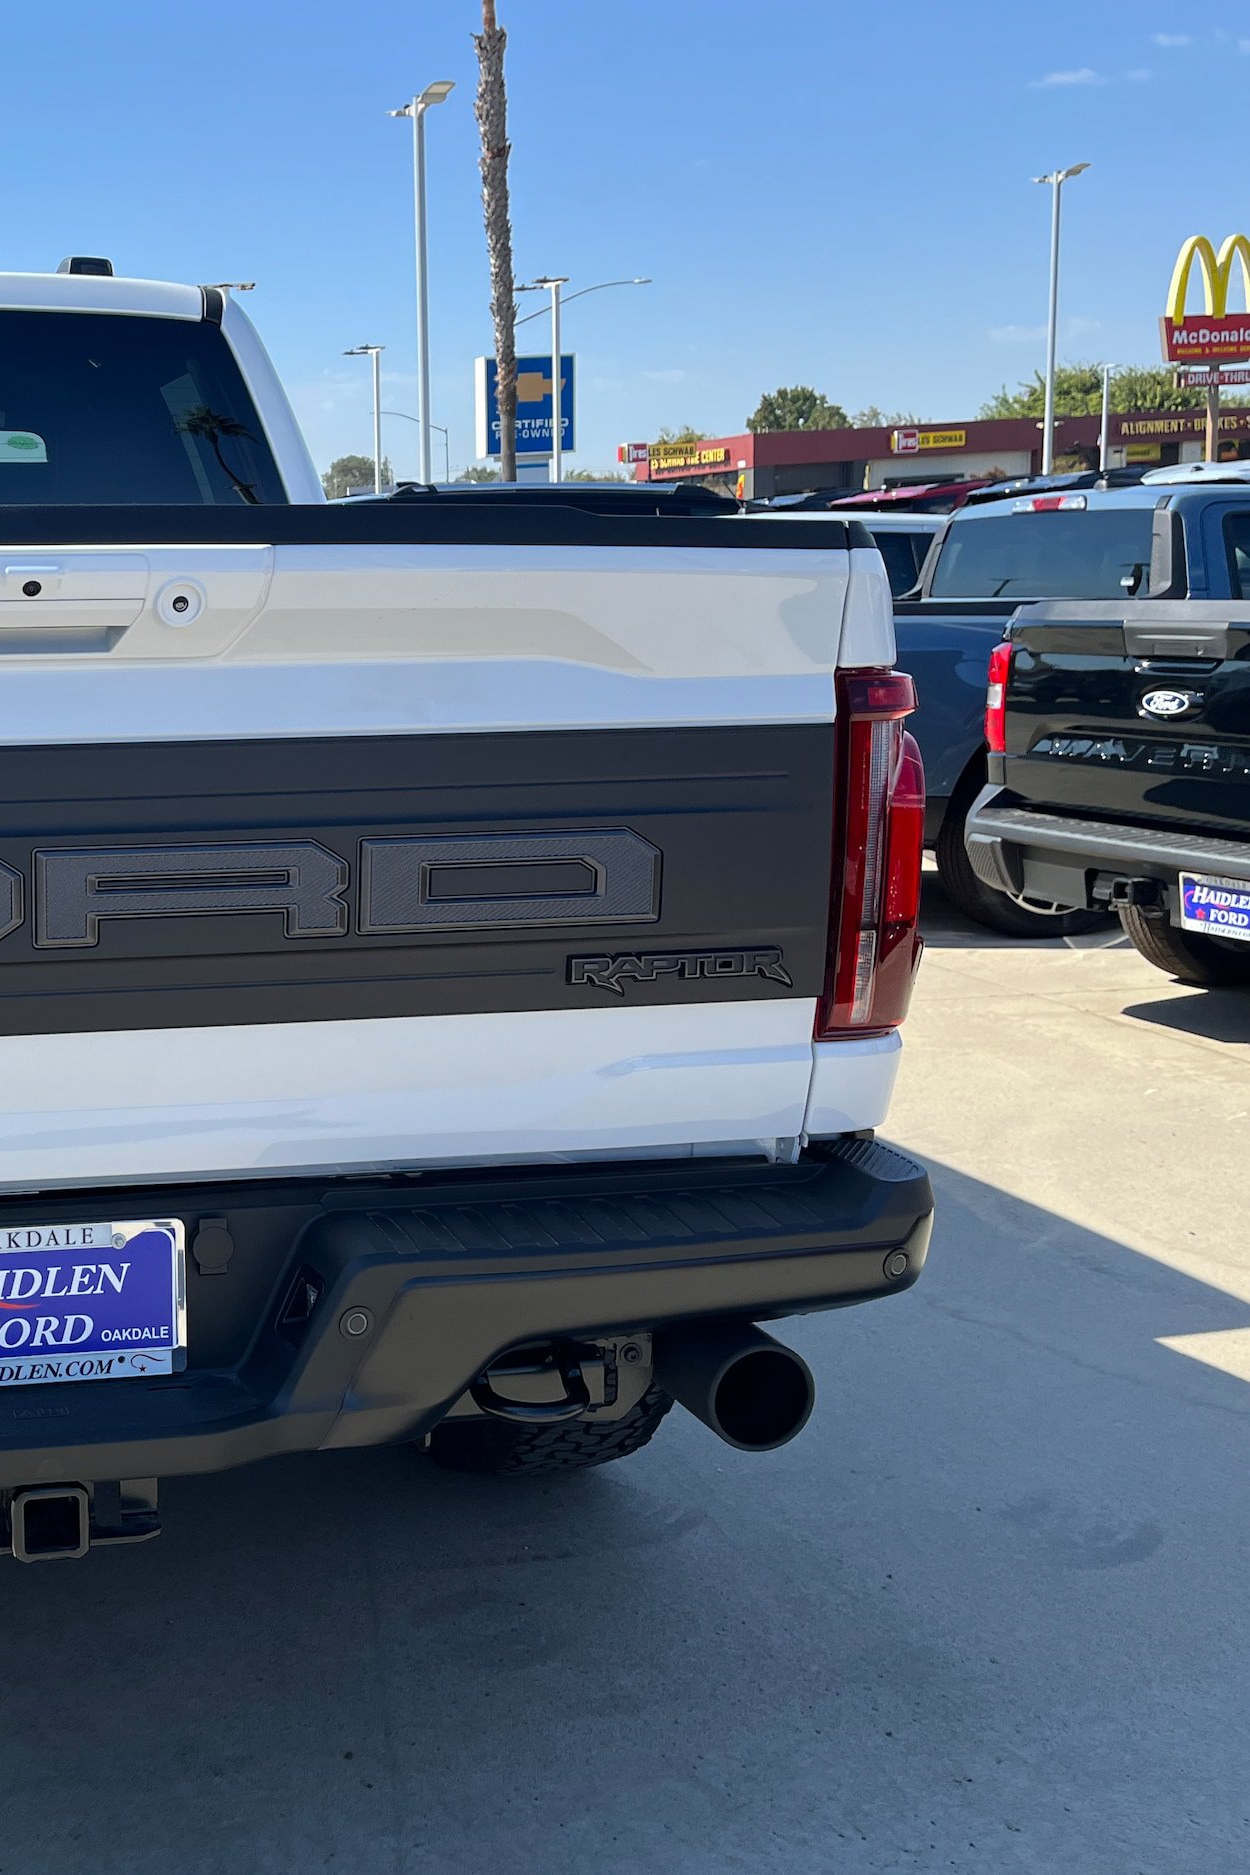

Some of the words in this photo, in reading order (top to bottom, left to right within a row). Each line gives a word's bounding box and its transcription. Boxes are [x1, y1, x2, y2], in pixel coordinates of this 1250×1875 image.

[491, 417, 569, 430] CRTIFID
[1121, 419, 1185, 435] ALIGNMENT
[1193, 415, 1237, 431] BRKES
[648, 446, 660, 457] LES
[664, 445, 694, 456] SCHWAB
[701, 448, 725, 464] CENTER
[1192, 885, 1250, 910] HAIDLE
[1209, 908, 1249, 927] FORD
[566, 945, 793, 996] RAPTOR
[100, 1325, 170, 1342] OAKDALE
